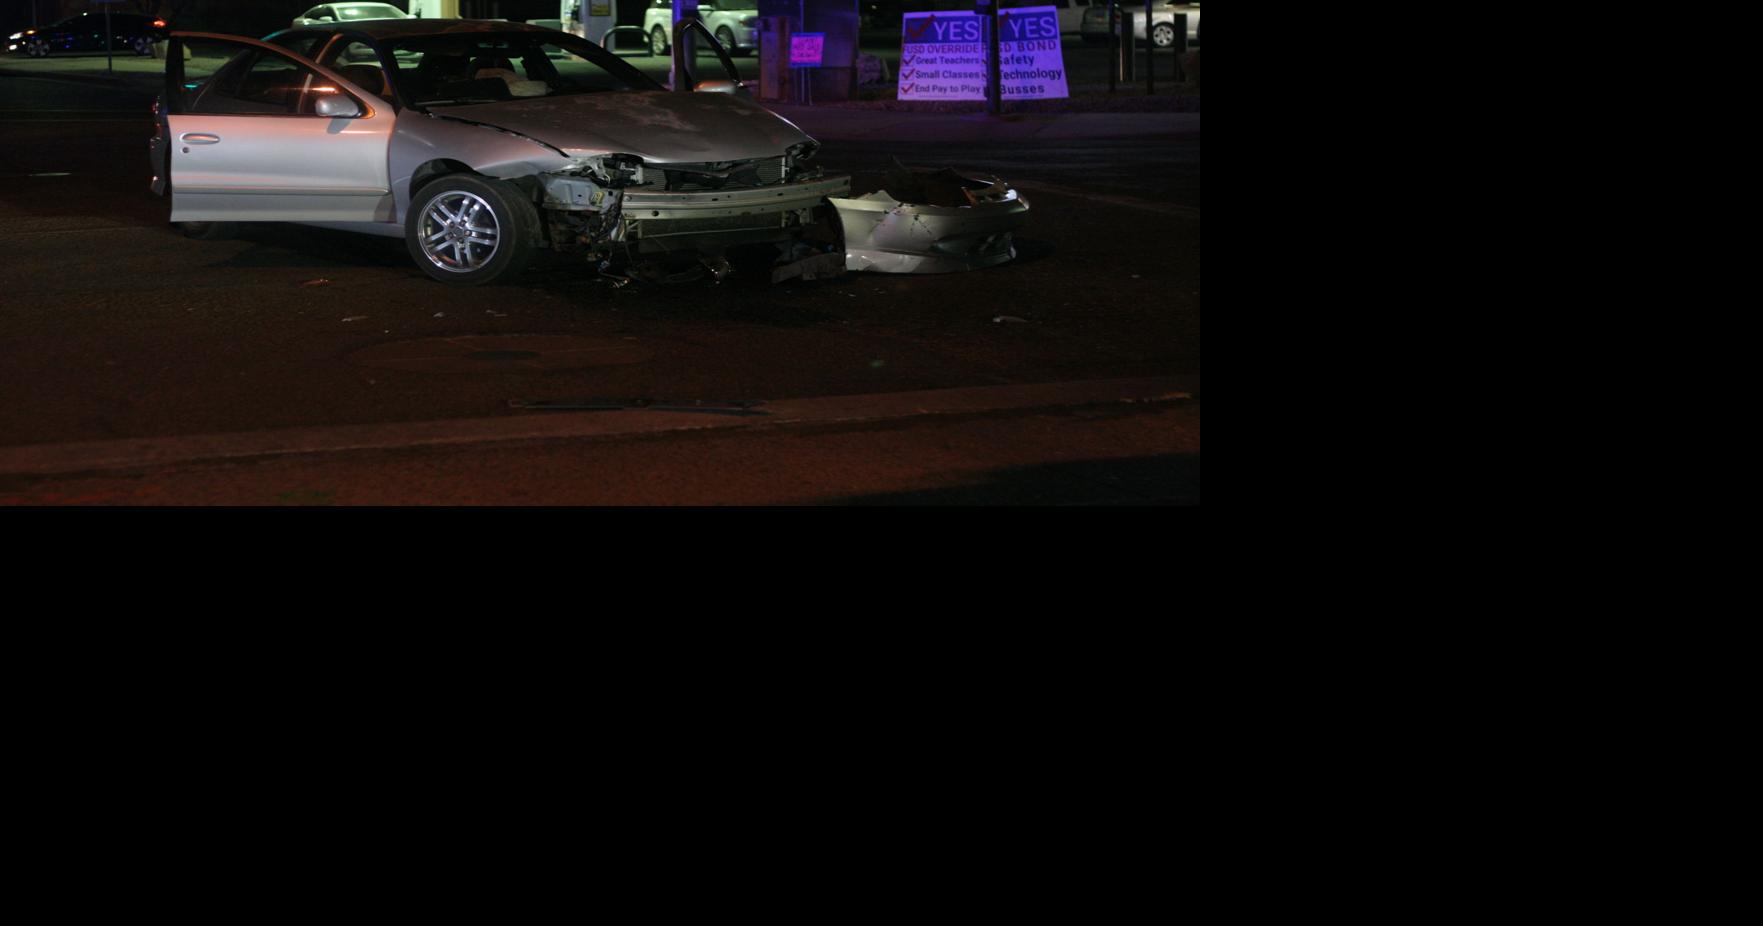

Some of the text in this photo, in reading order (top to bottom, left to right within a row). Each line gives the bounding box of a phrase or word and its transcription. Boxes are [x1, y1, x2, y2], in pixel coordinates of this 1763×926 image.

[934, 20, 980, 41] YES
[1009, 16, 1056, 38] YES
[927, 43, 979, 54] OVERRIDE
[1017, 39, 1056, 52] BOND
[915, 56, 980, 65] Great Teachers
[915, 70, 980, 79] Small Classes
[915, 85, 981, 95] End Pay to Play
